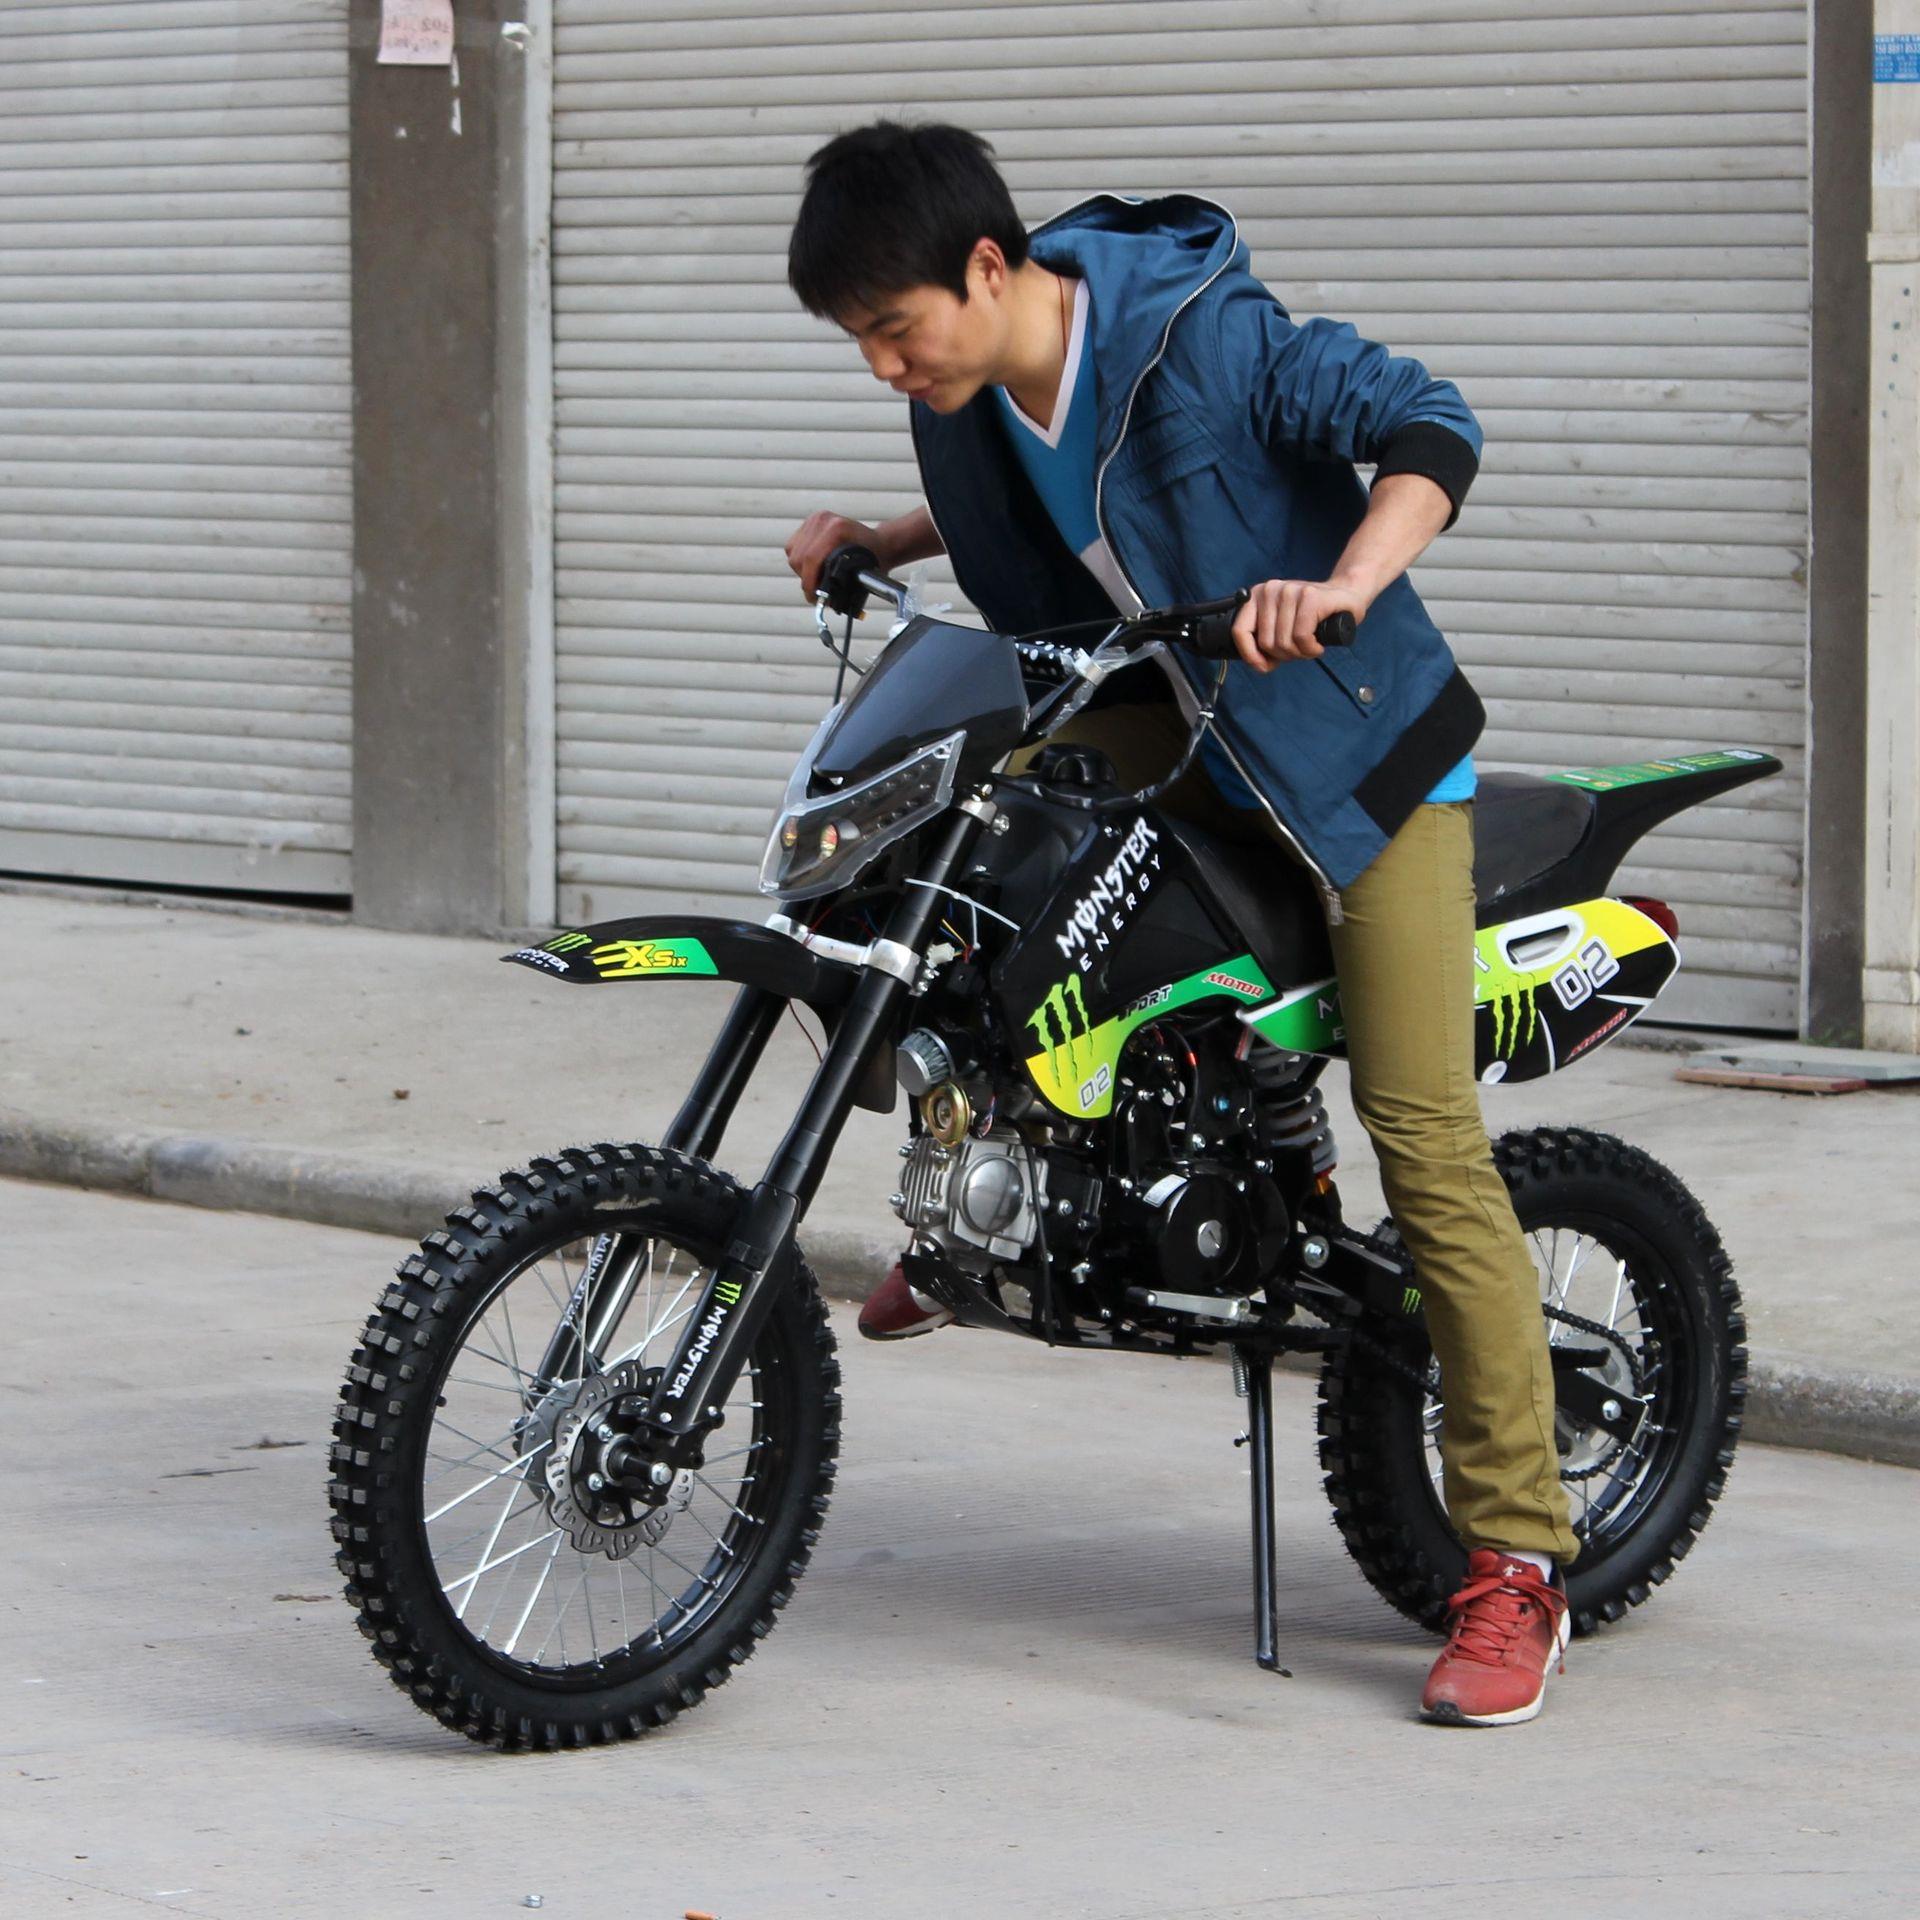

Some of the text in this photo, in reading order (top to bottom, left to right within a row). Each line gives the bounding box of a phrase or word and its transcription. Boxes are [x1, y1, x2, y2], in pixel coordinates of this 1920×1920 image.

[1056, 817, 1159, 959] MONSTER
[1079, 854, 1162, 972] ENERGY
[1202, 972, 1265, 998] MOTOR
[1551, 936, 1621, 1011] 02
[1079, 1063, 1113, 1110] 02
[666, 1305, 728, 1399] MONSTER
